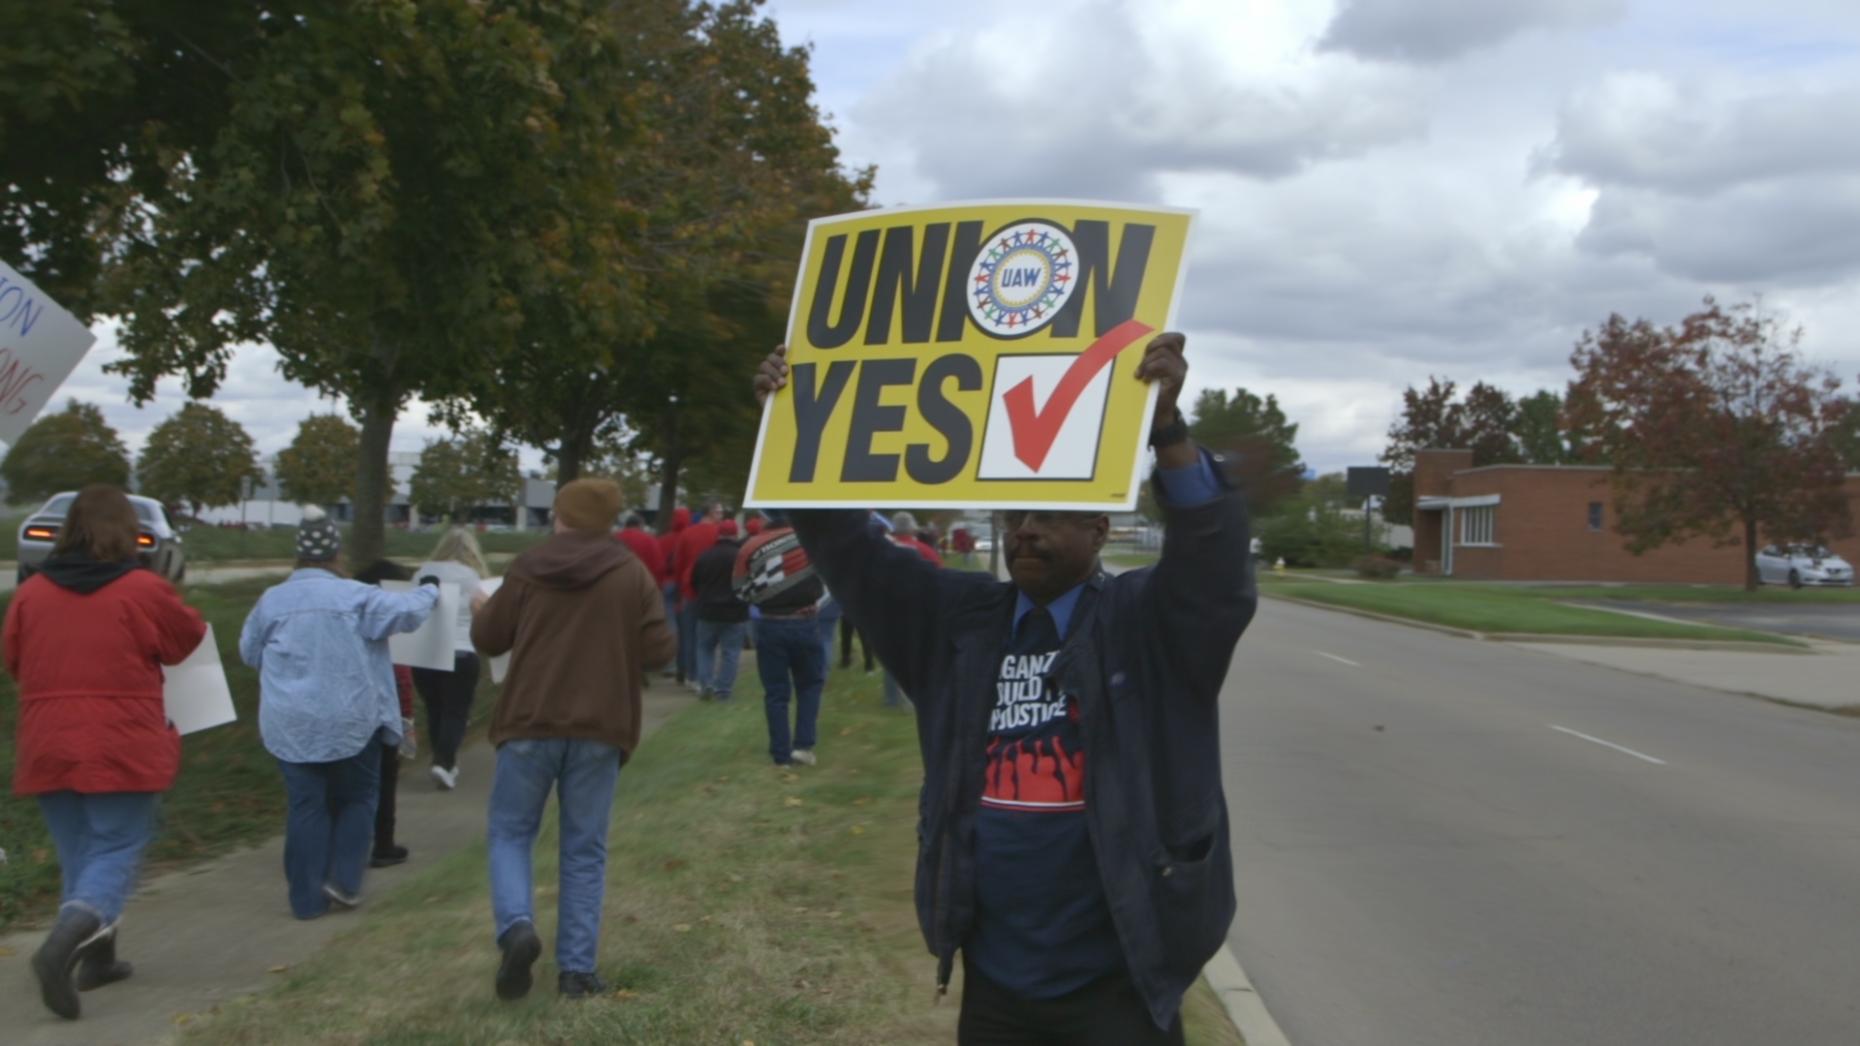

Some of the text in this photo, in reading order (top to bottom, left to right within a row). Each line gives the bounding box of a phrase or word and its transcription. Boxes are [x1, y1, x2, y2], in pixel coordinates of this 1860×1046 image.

[806, 218, 1156, 349] UNION
[1001, 267, 1042, 288] UAW
[788, 353, 983, 485] YES
